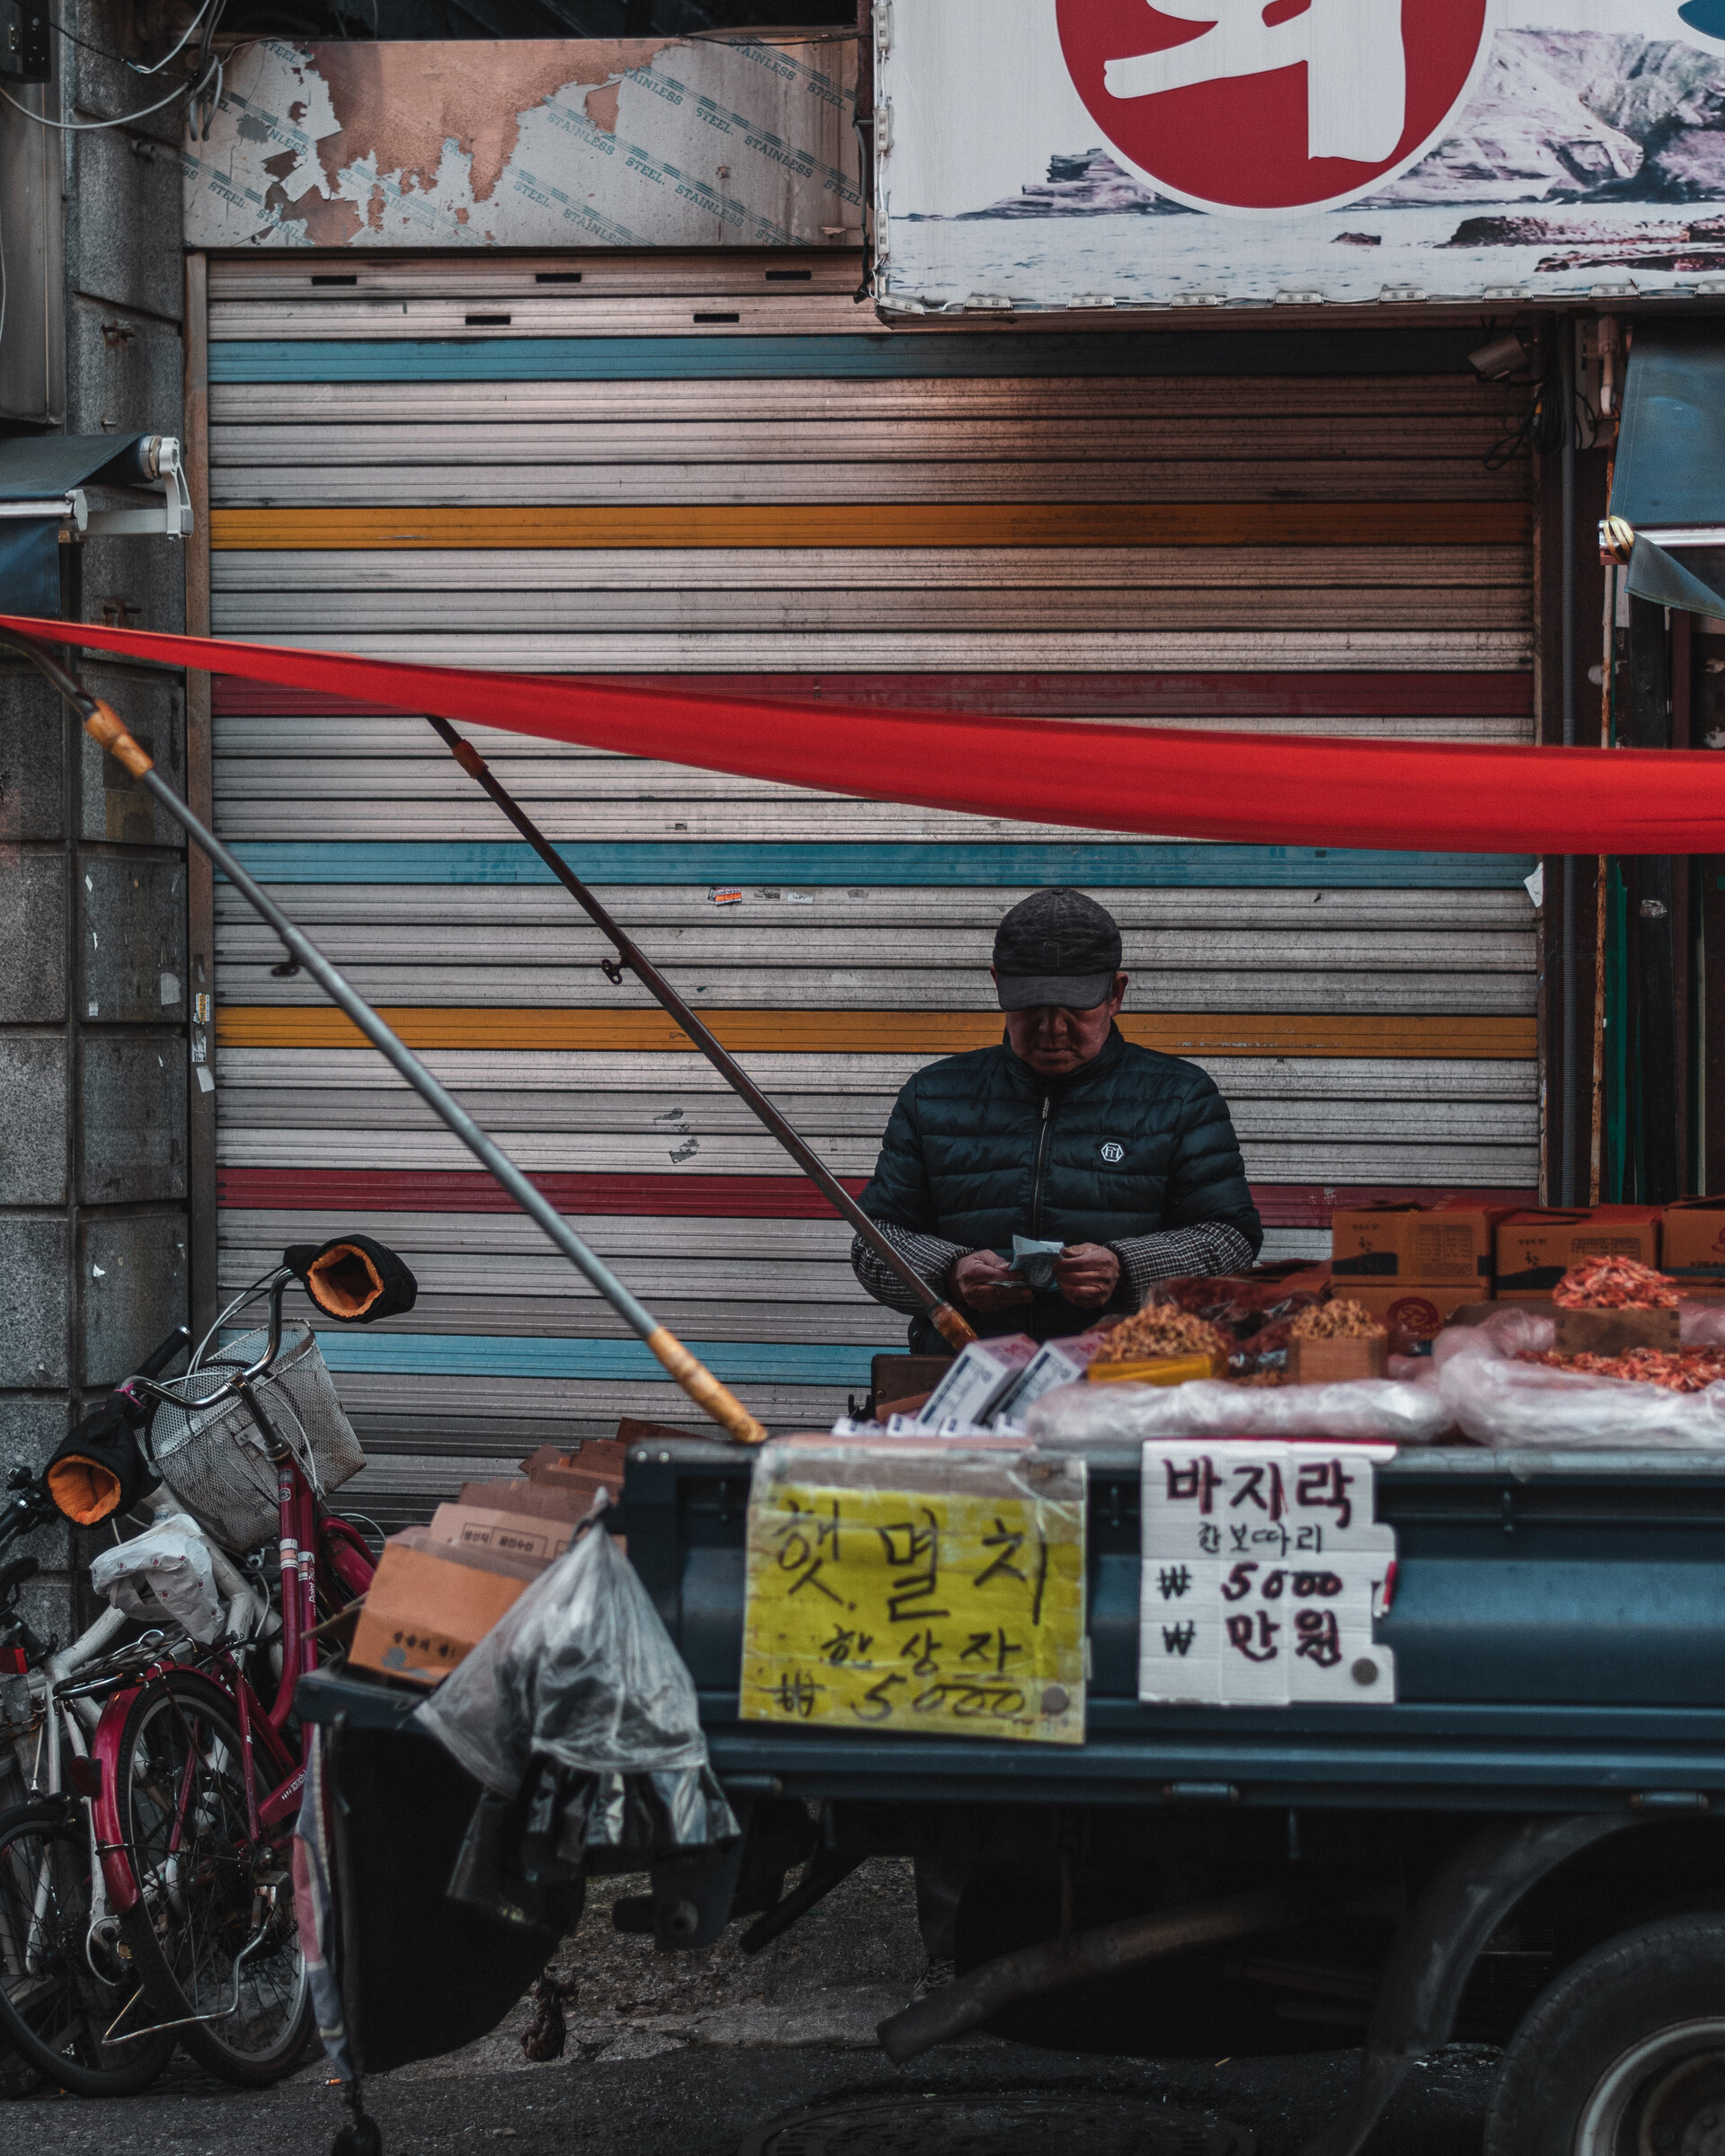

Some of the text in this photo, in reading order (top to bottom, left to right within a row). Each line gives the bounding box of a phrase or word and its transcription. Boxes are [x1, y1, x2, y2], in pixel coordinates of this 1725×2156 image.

[546, 112, 615, 155] STAINLESS
[625, 156, 666, 185] STEEL.
[676, 184, 745, 227] STAINLESS
[744, 135, 814, 178] STAINLESS
[208, 181, 247, 209] STEEL.
[513, 181, 553, 209] STEEL.
[1162, 1455, 1354, 1529] 바지락
[1221, 1561, 1343, 1602] 5000
